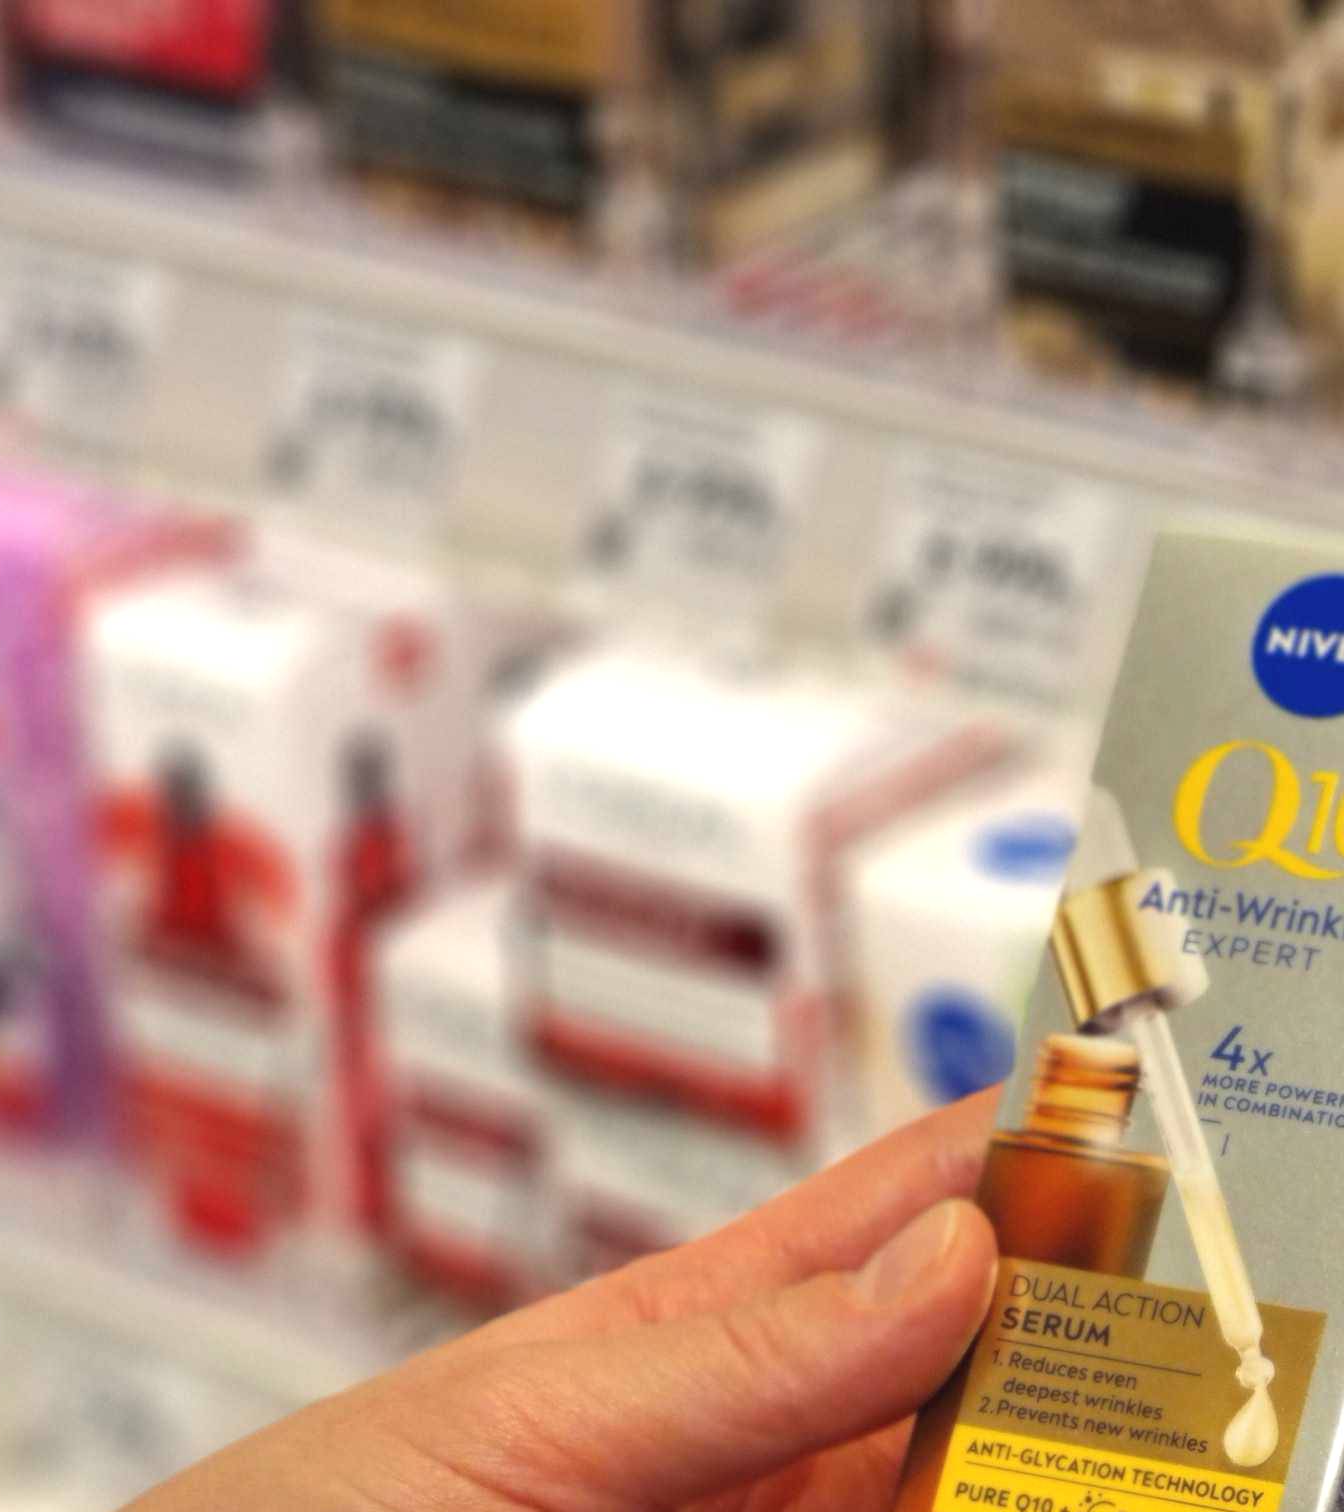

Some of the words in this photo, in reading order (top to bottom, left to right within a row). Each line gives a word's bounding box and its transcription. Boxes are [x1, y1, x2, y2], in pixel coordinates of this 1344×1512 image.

[1182, 929, 1321, 972] EXPERT
[1197, 1091, 1218, 1107] IN
[1202, 1073, 1261, 1095] MORE
[1009, 1274, 1086, 1310] DUAL
[1091, 1292, 1206, 1329] ACTION
[1001, 1306, 1111, 1347] SERUM
[991, 1350, 1003, 1367] 1.
[1008, 1351, 1087, 1381] Reduces
[1093, 1370, 1137, 1389] even
[1002, 1378, 1080, 1406] deepest
[1085, 1395, 1164, 1420] wrinkles
[1082, 1417, 1125, 1437] new
[1128, 1427, 1208, 1453] wrinkles
[966, 1439, 1127, 1481] ANTI-GLYCATION
[1132, 1468, 1264, 1508] TECHNOLOGY
[954, 1481, 1011, 1508] PURE
